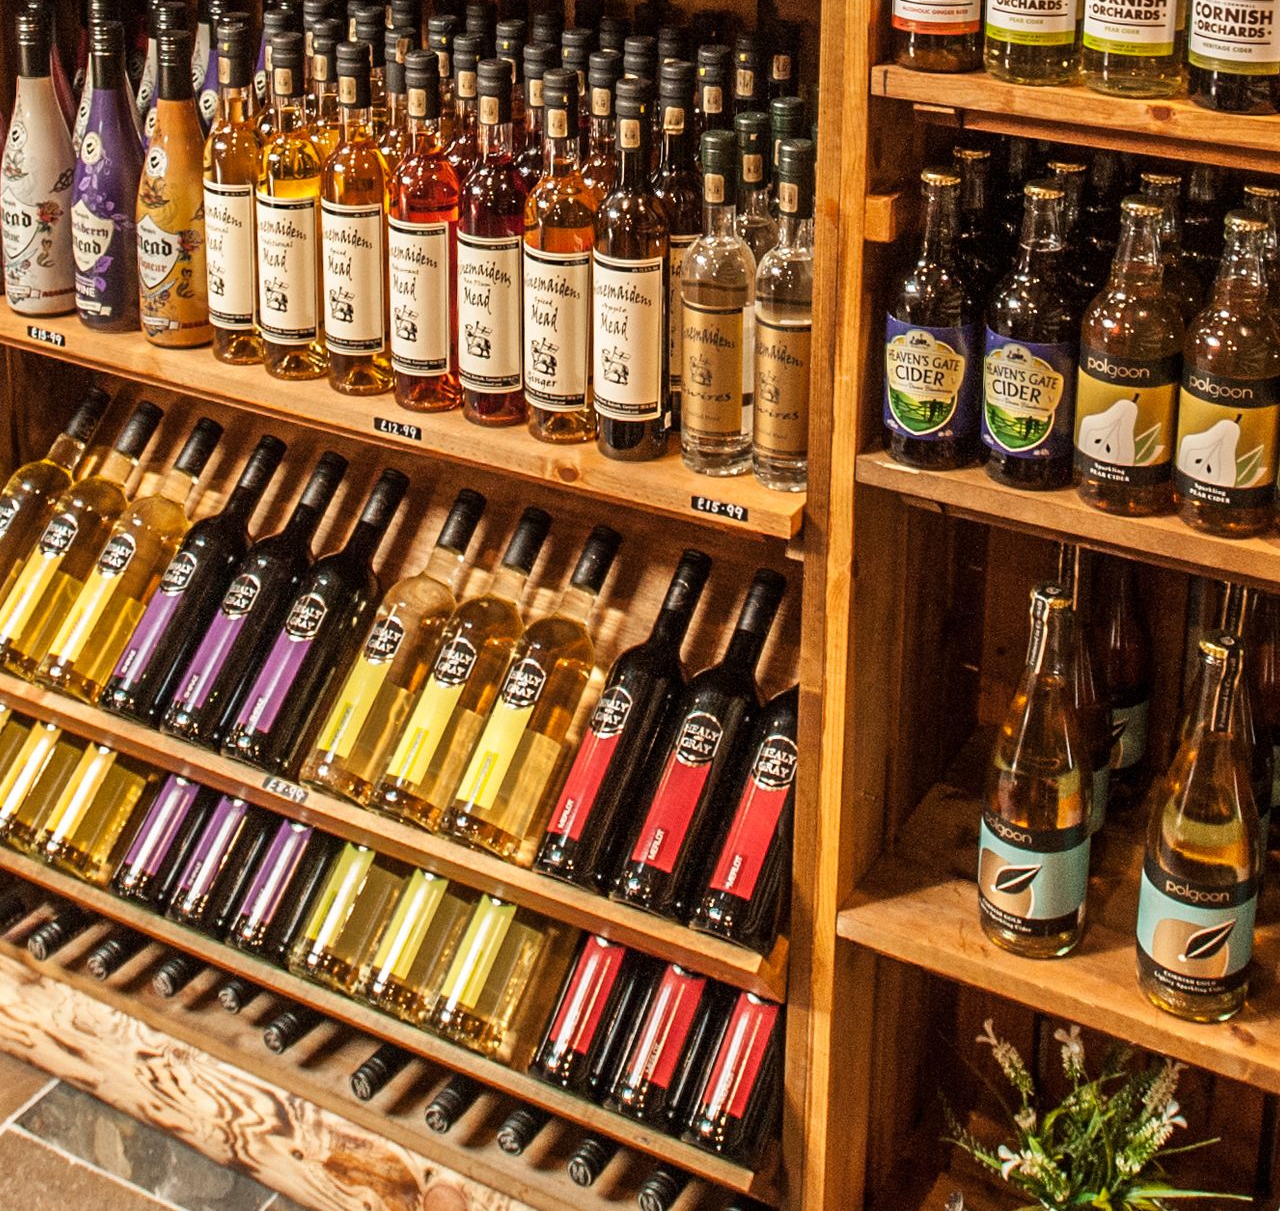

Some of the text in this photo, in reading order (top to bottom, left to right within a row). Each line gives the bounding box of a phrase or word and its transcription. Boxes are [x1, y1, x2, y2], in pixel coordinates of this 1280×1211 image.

[1092, 4, 1160, 20] ORCHARDS
[1195, 2, 1273, 25] CORNISH
[1197, 21, 1266, 38] ORCHARDS
[464, 289, 491, 315] Mead
[532, 305, 558, 332] Mead
[933, 357, 960, 371] GATE
[1087, 356, 1150, 378] polgoon
[895, 365, 944, 386] CIDER
[1029, 373, 1059, 389] GATE
[992, 380, 1041, 403] CIDER
[1190, 376, 1253, 400] polgoon
[381, 420, 417, 438] £12.99
[697, 498, 743, 519] £15.99
[685, 723, 719, 741] HEALY
[681, 737, 713, 754] GRAY
[763, 747, 797, 765] HEALY
[758, 762, 790, 777] GRAY
[558, 799, 574, 828] MERLOT
[648, 829, 665, 860] MERLOT
[1166, 880, 1230, 903] polgoon
